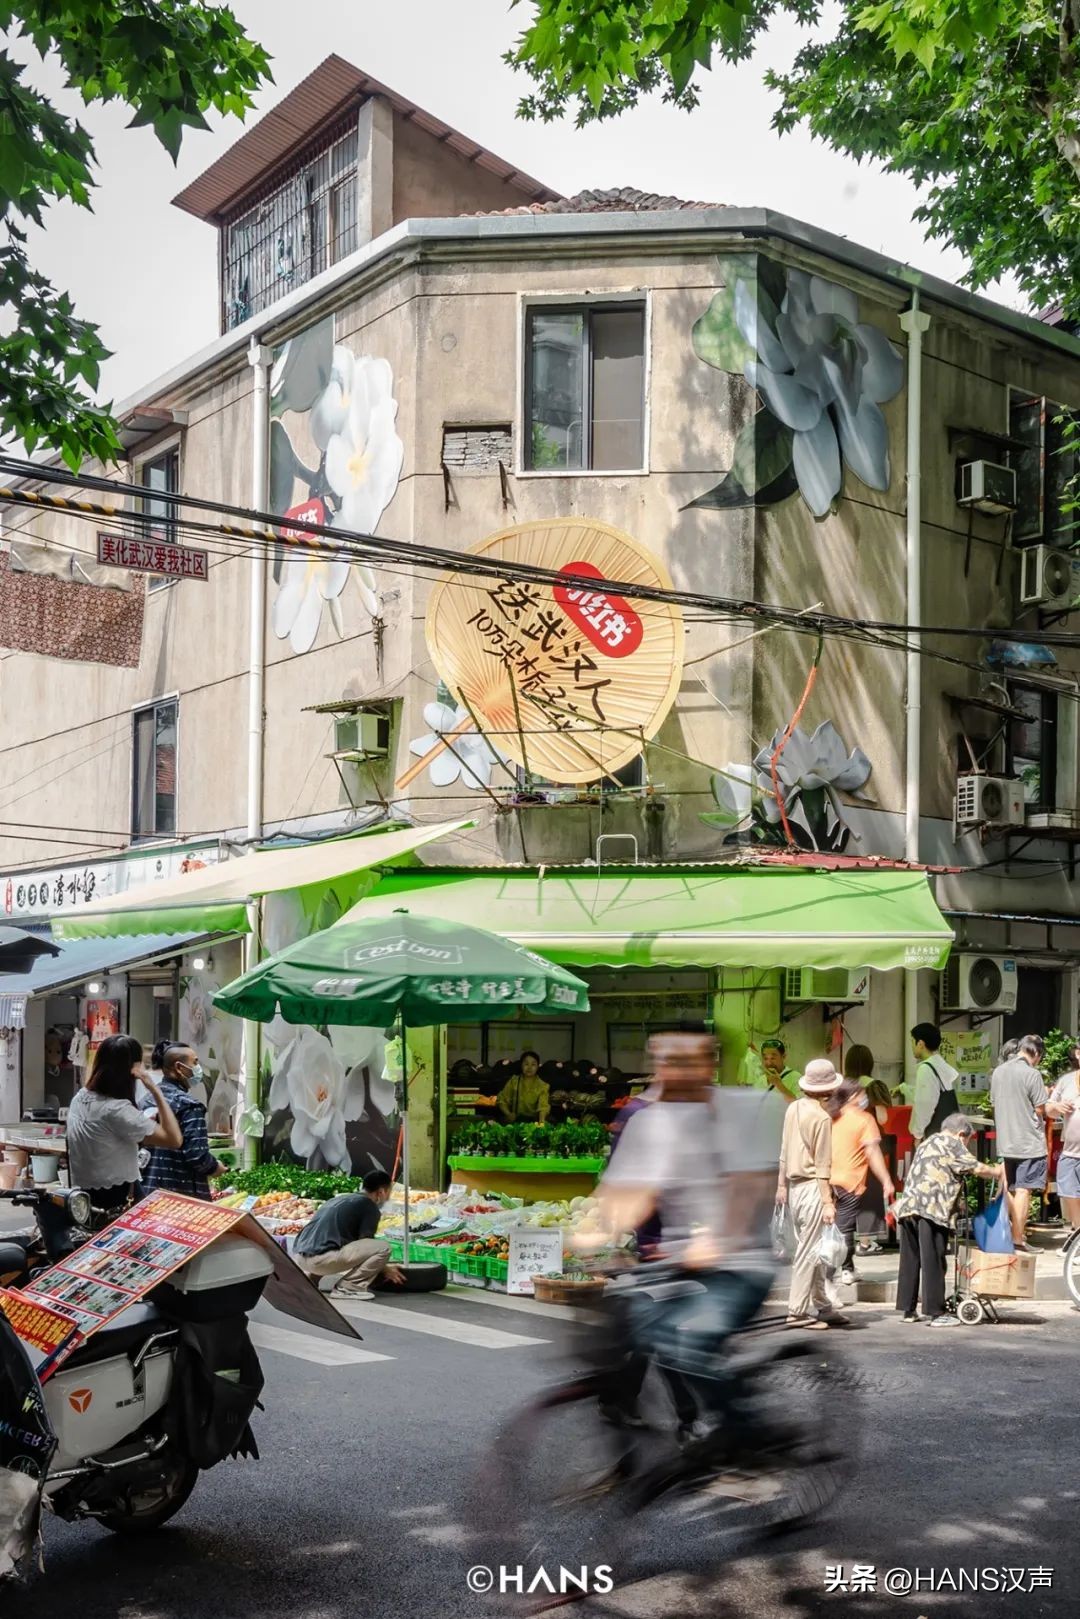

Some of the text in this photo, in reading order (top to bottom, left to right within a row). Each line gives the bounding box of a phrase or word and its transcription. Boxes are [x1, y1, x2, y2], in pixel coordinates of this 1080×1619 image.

[102, 537, 205, 576] 美化武汉爱我社区
[487, 580, 612, 722] 送武汉人
